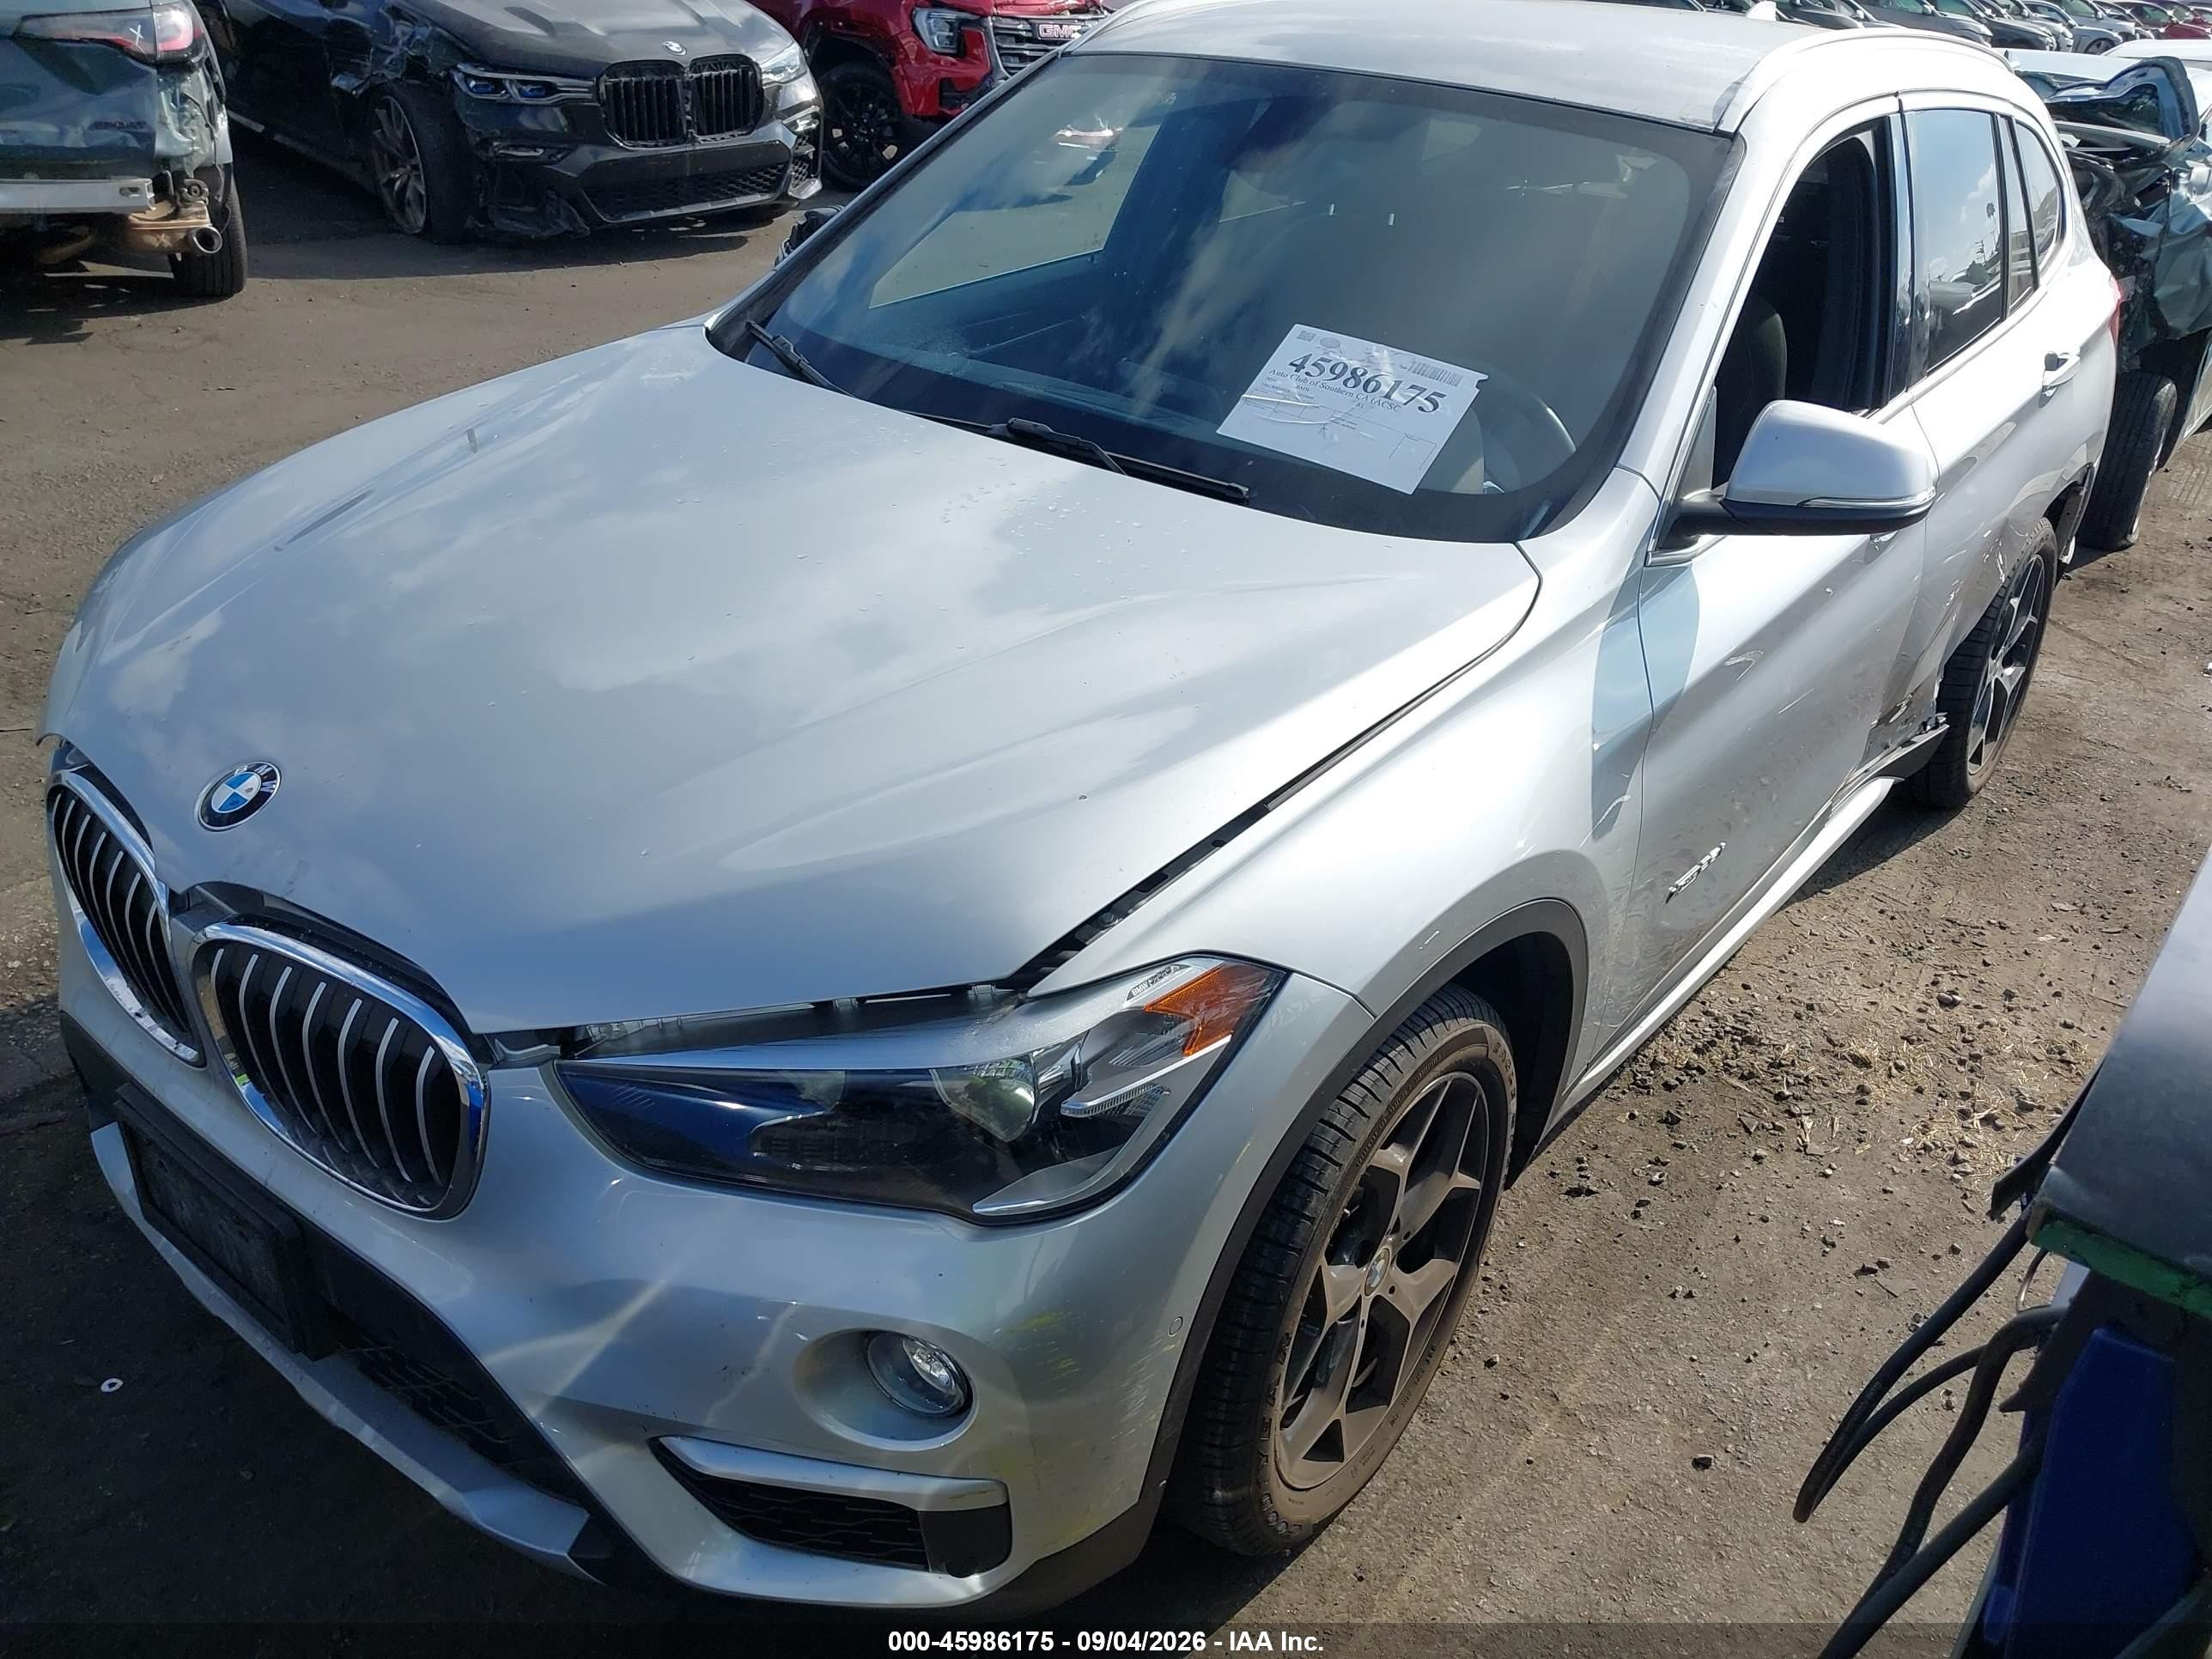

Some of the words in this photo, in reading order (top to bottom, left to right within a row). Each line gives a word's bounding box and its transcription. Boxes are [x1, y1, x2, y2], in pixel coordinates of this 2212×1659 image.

[1038, 24, 1082, 39] GMC
[1268, 368, 1289, 380] Auto
[1289, 371, 1309, 385] Club
[1318, 380, 1355, 398] Southern
[1355, 392, 1370, 401] CA
[1288, 353, 1448, 413] 45986175
